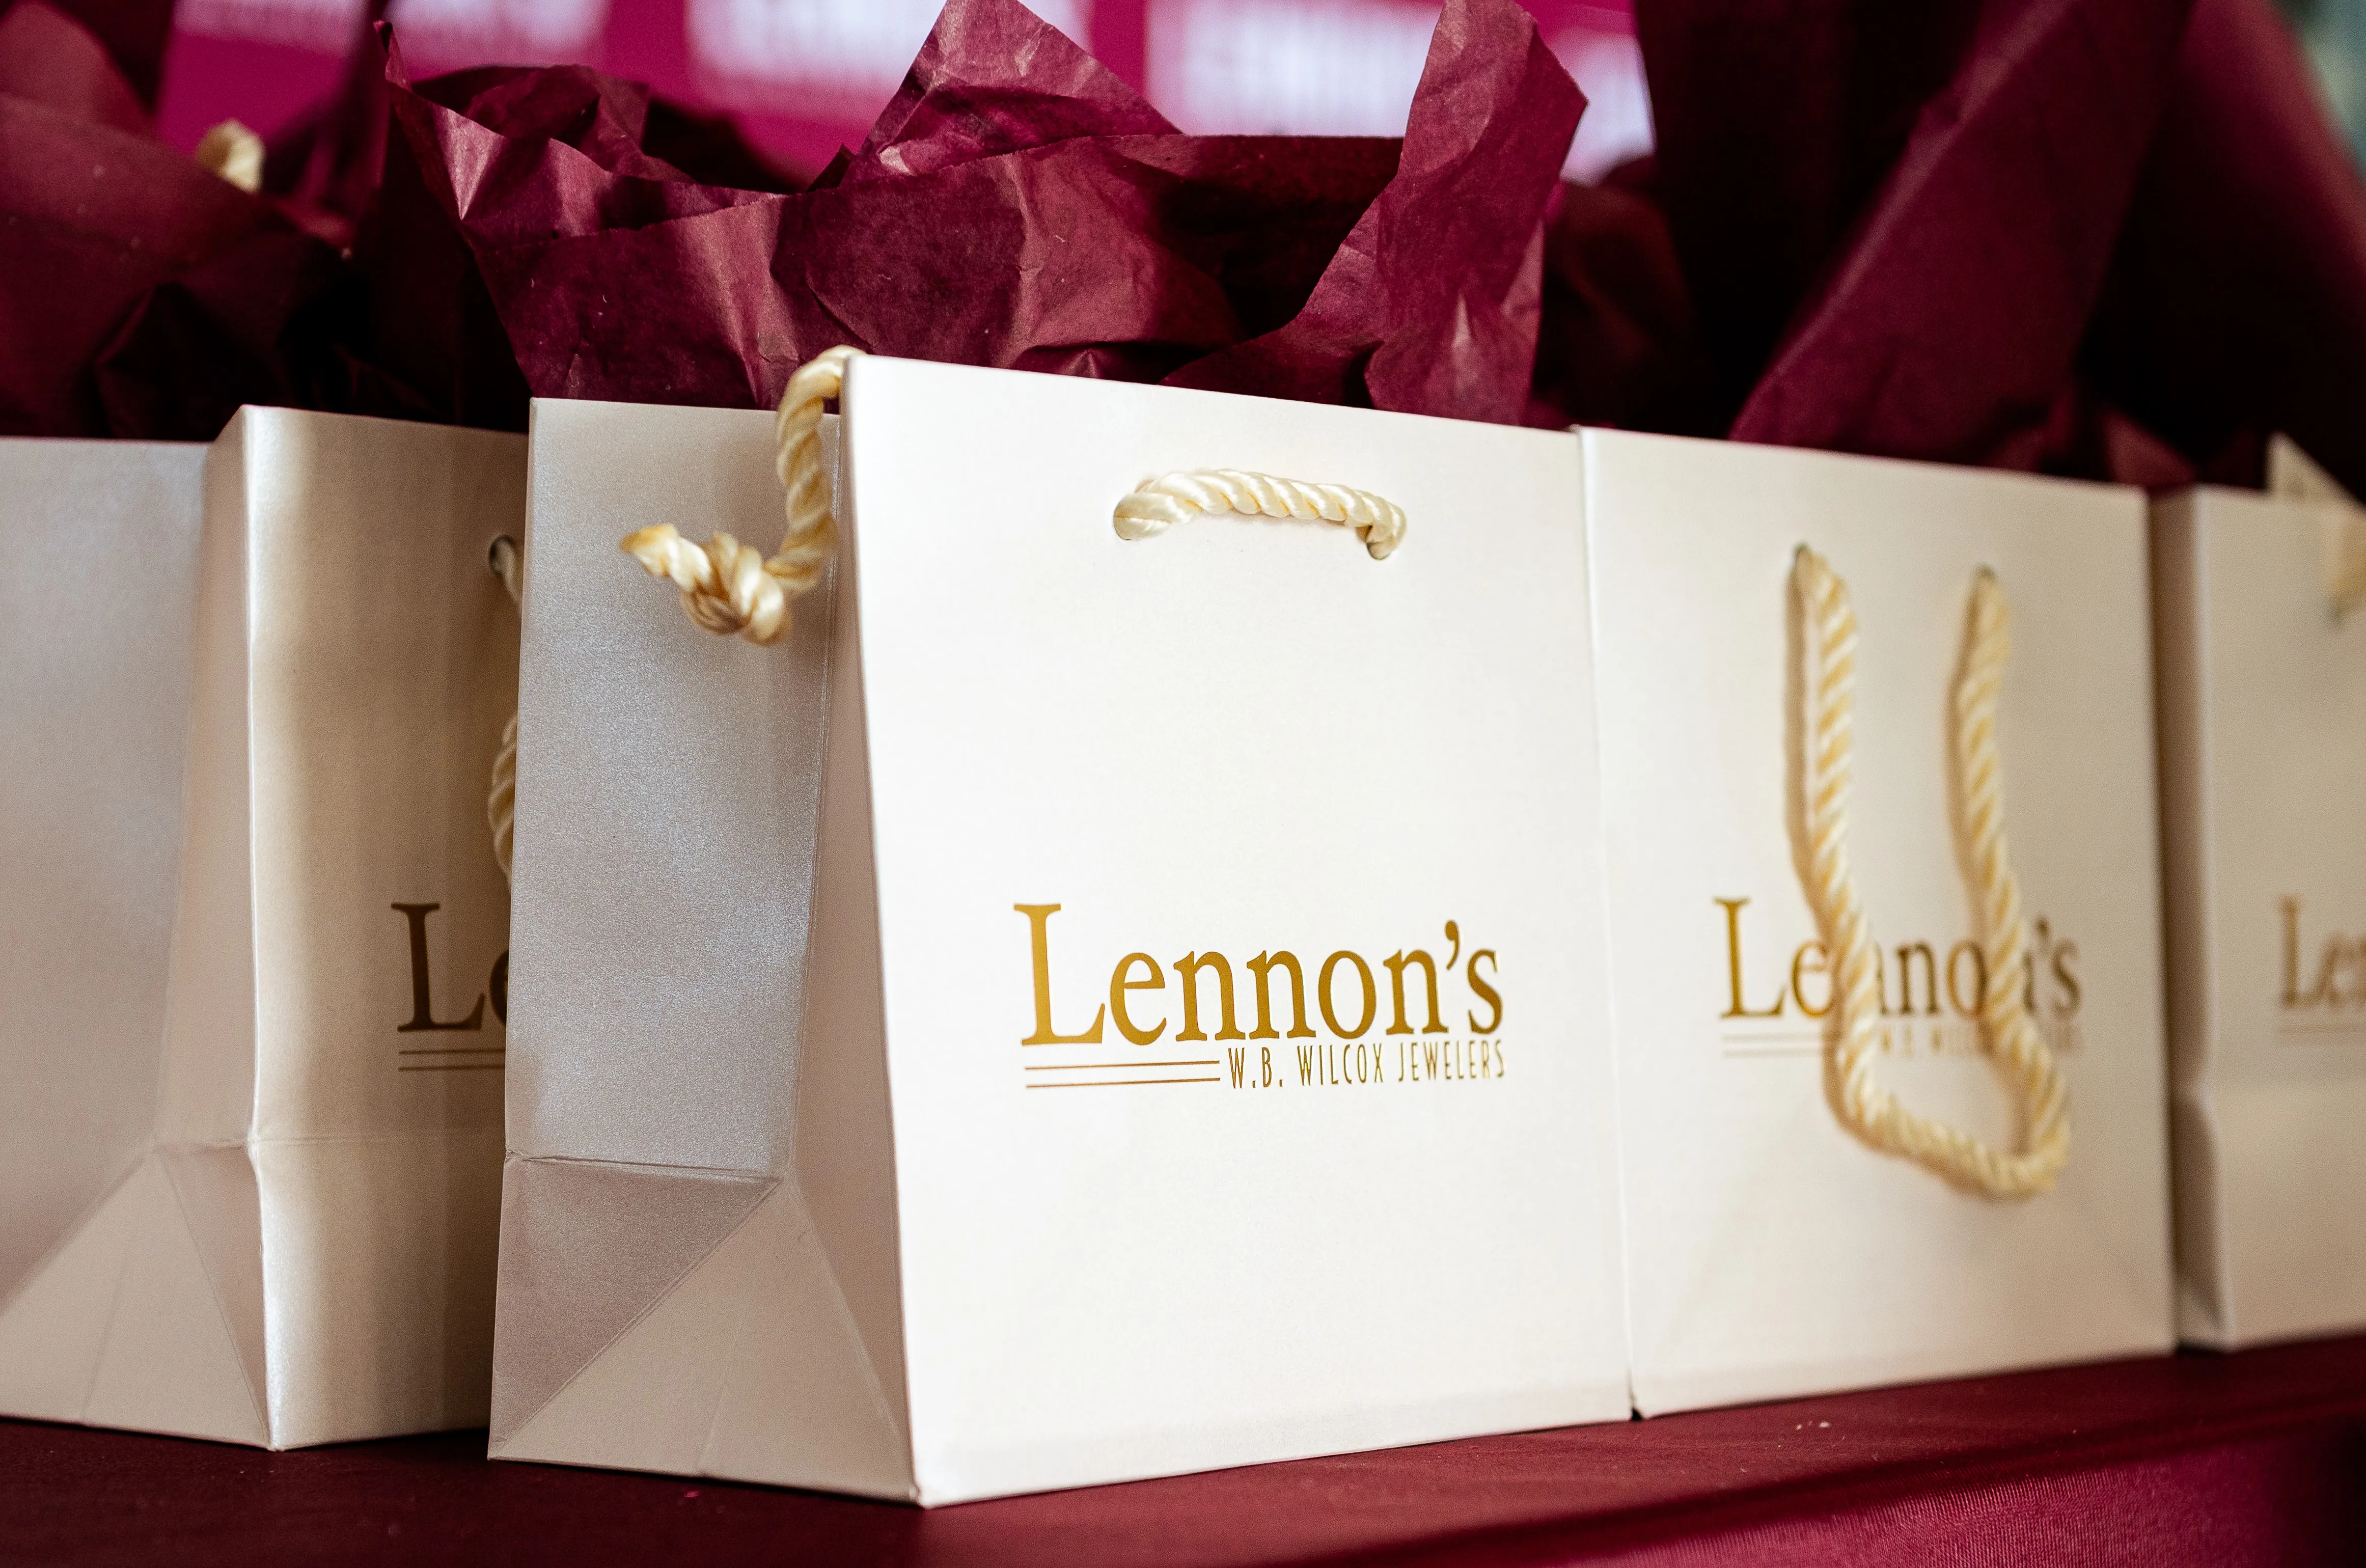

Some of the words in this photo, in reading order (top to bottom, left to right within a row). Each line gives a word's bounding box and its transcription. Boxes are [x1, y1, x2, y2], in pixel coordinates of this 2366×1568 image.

[1013, 902, 1504, 1047] Lennon's
[1228, 1047, 1284, 1089] W.B.
[1297, 1043, 1384, 1087] WILCOX
[1398, 1039, 1505, 1082] JEWELERS
